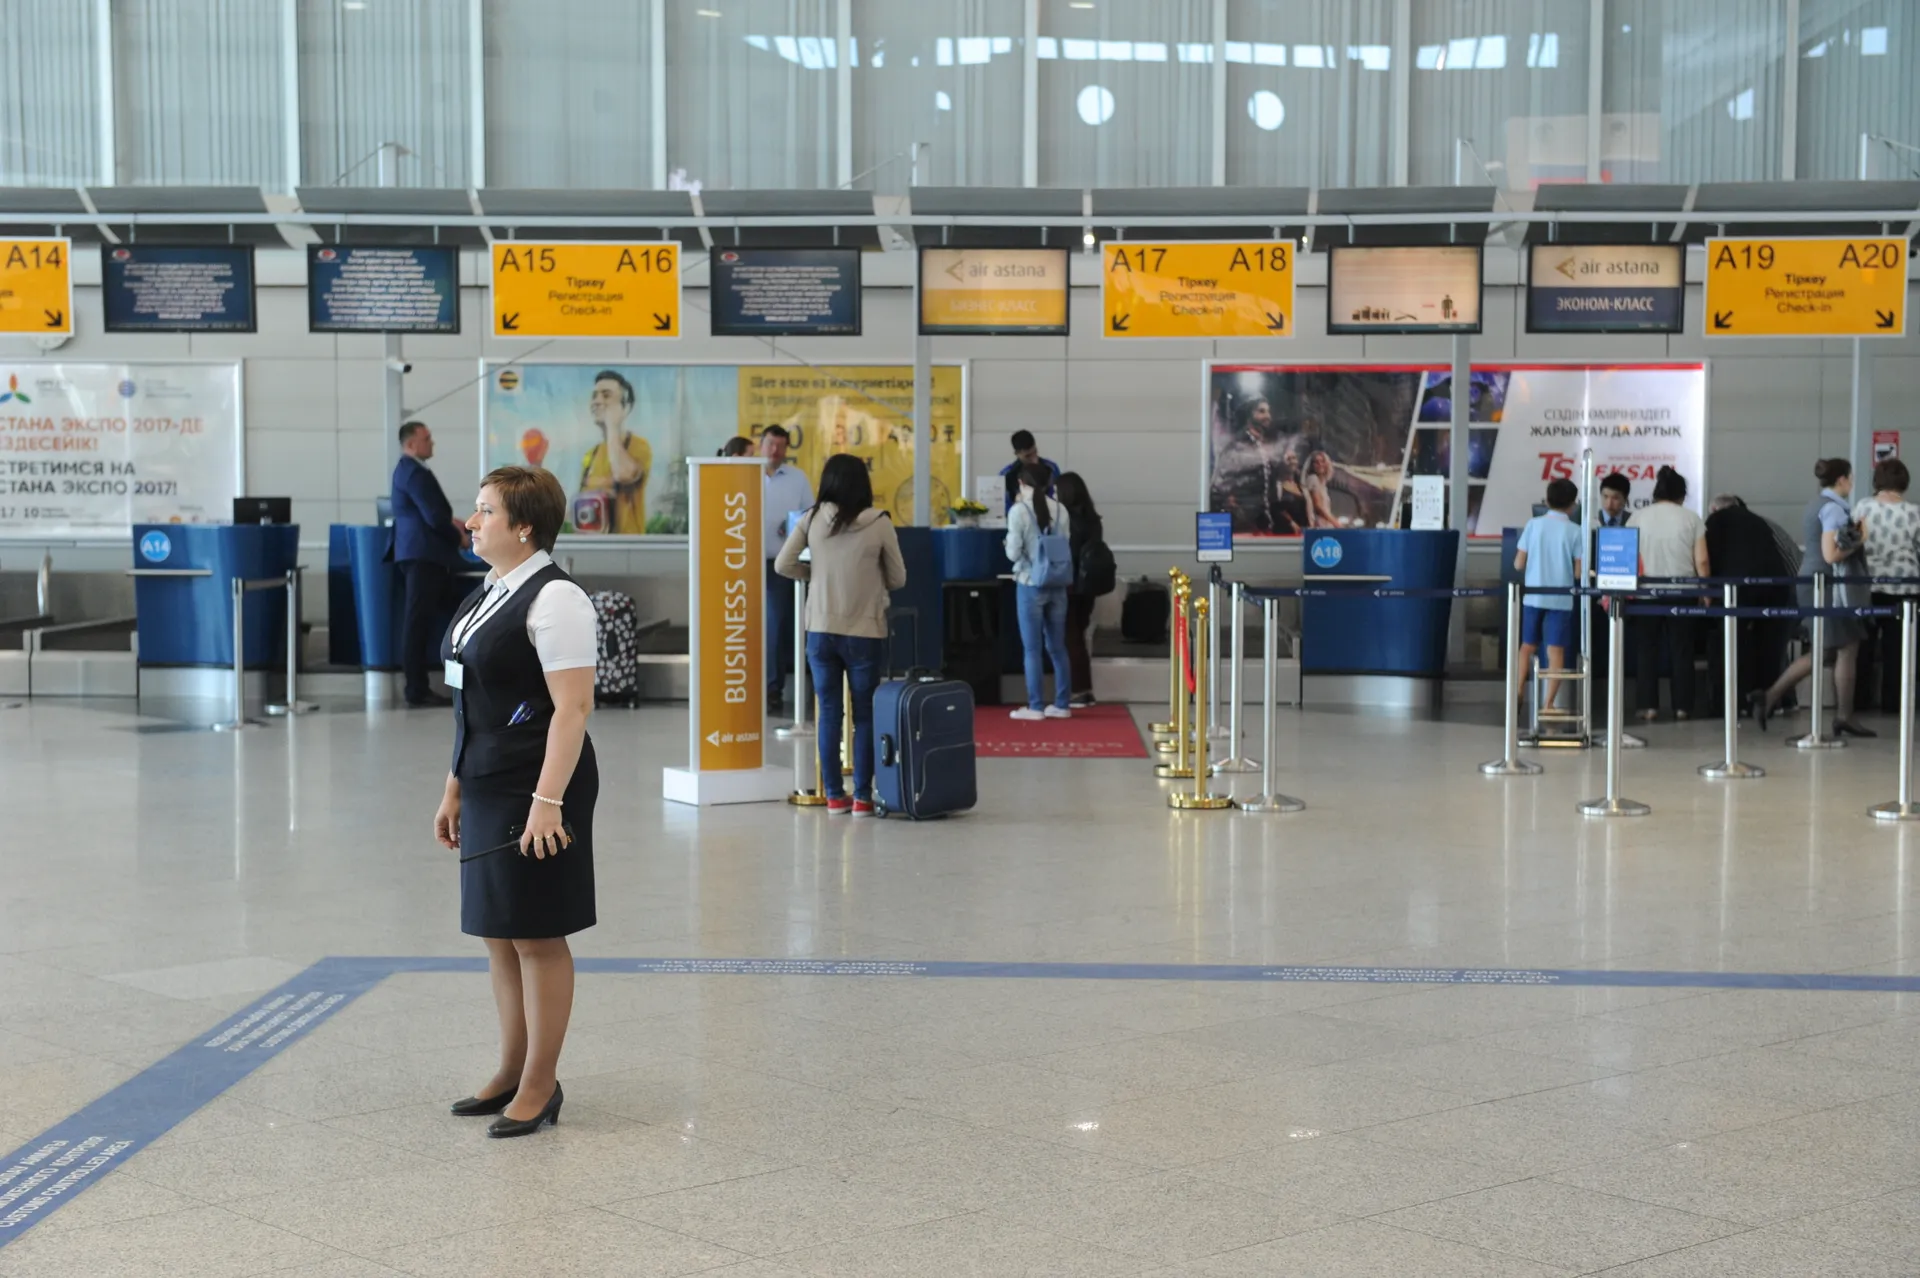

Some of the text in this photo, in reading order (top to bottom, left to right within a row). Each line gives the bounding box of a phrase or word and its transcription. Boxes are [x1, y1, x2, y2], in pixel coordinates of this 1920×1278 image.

[6, 245, 62, 269] A14
[500, 248, 672, 272] A15 A16
[1111, 247, 1287, 272] A17 A18
[1715, 243, 1899, 270] A19 A20
[969, 261, 1046, 277] air astana
[1581, 257, 1660, 274] air astana
[560, 304, 612, 315] Check-in
[1171, 304, 1224, 315] Check-in
[1556, 296, 1655, 311] ЭКОНОМ-КЛАСС
[1777, 302, 1832, 313] Check-in
[61, 416, 127, 433] ЭКСПО
[133, 417, 204, 435] 2017-ДЕ
[1610, 425, 1631, 438] ДА
[0, 434, 98, 452] ЗДЕСЕЙІК!
[111, 460, 136, 475] НА
[1538, 452, 1575, 481] TS
[63, 480, 128, 495] ЭКСПО
[134, 481, 178, 496] 2017!
[143, 539, 169, 553] A14
[1313, 545, 1341, 559] A18
[725, 491, 747, 703] BUSINESS CLASS
[721, 731, 760, 744] air astana
[0, 1139, 135, 1228] CUSTOMS CONTROLLED AREA
